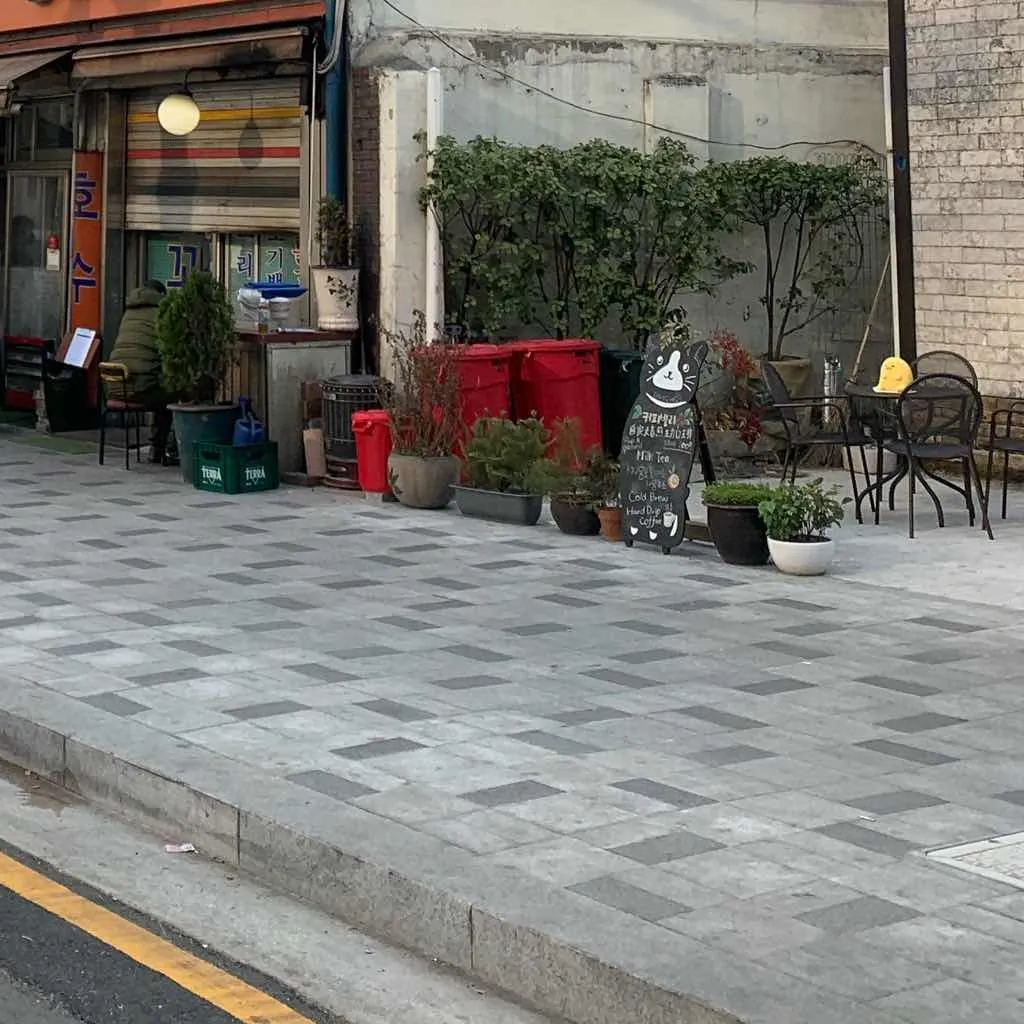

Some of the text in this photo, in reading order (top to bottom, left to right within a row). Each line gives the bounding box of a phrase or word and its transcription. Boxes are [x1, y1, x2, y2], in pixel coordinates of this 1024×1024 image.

[655, 451, 670, 463] Tea
[201, 465, 222, 481] TERRA
[244, 465, 266, 481] TERRA
[628, 491, 647, 503] Cold
